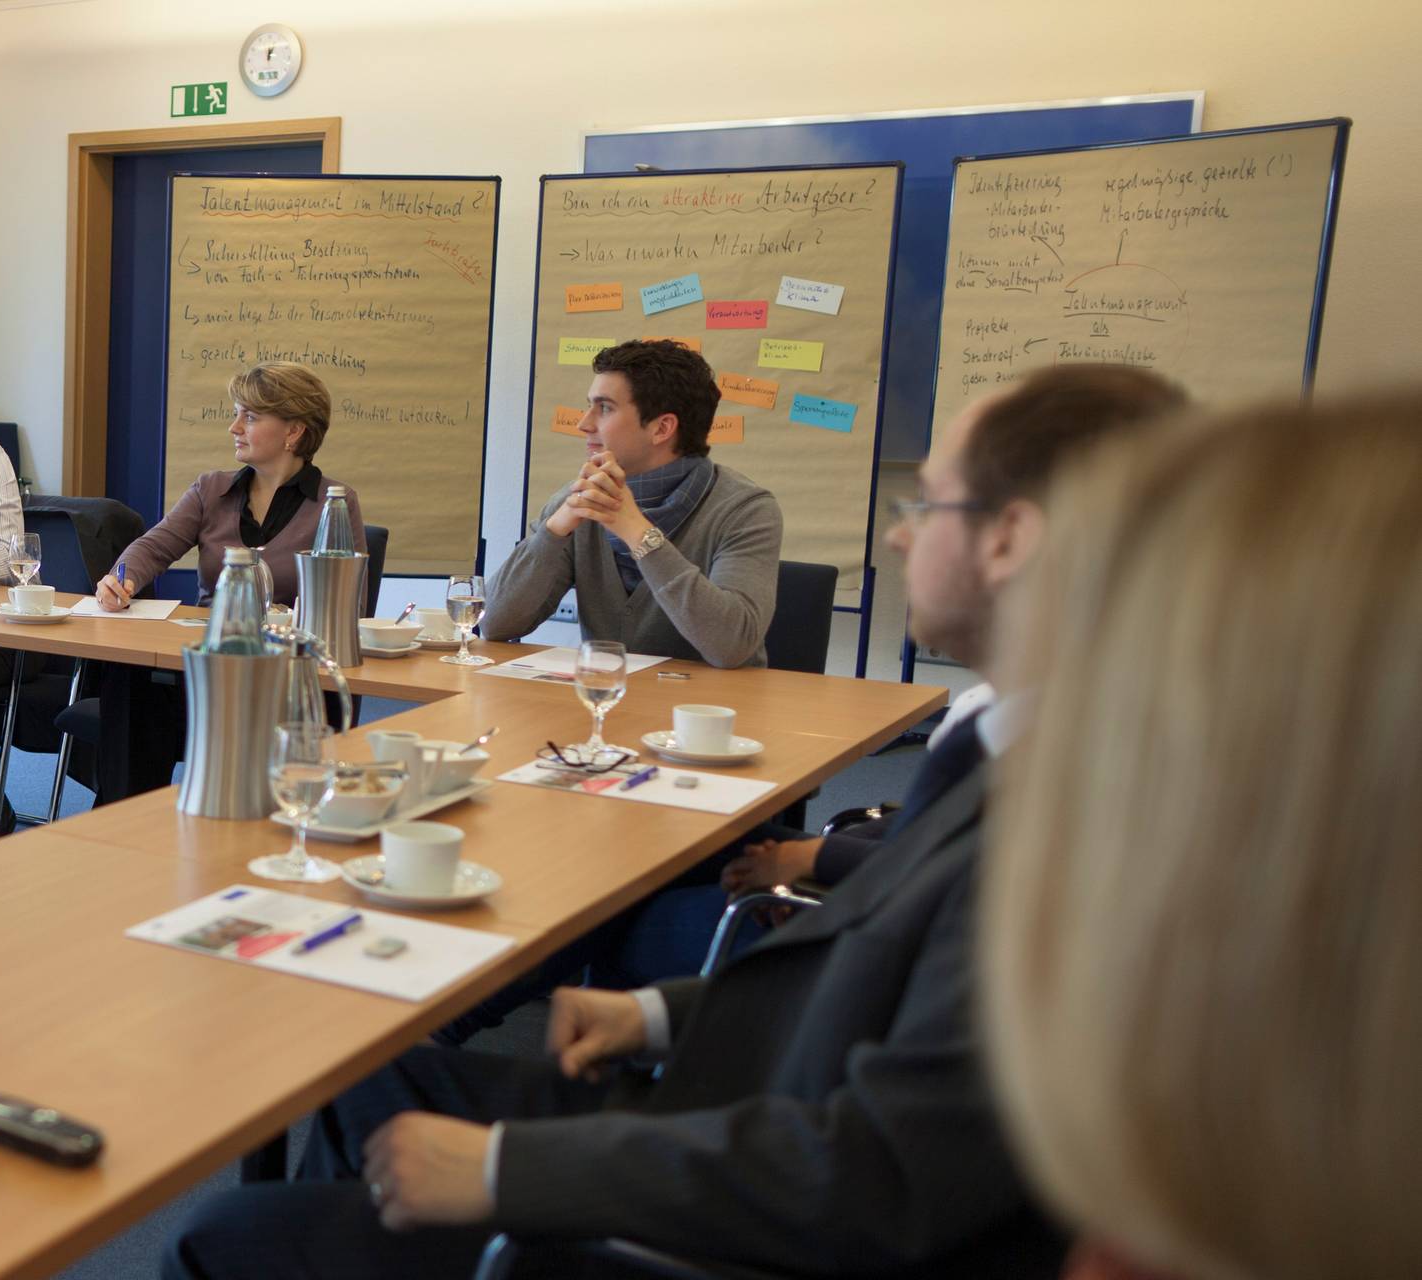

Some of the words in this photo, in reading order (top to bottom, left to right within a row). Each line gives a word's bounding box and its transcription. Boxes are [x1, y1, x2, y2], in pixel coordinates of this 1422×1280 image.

[1201, 157, 1257, 193] gezielte
[200, 186, 342, 222] Talentmanagement
[354, 199, 371, 210] im
[379, 190, 465, 217] Mittelstand
[562, 190, 590, 211] Bin
[602, 190, 620, 208] ich
[627, 197, 650, 208] ein
[661, 184, 743, 207] attraktiver
[756, 179, 859, 217] Arbeitgeber
[865, 178, 876, 195] ?
[1098, 198, 1230, 231] Mitarbeitergespräche
[204, 239, 296, 272] Sicherstellung
[302, 238, 369, 264] Besetzung
[584, 239, 614, 262] Was
[626, 233, 699, 261] erwarten
[710, 229, 805, 257] Mitarbeiter
[815, 227, 824, 245] ?
[1008, 253, 1040, 269] nicht
[205, 270, 229, 284] von
[298, 264, 421, 294] Führungspositionen
[309, 299, 435, 335] Personalrekrutierung
[1063, 288, 1188, 316] Talentmanagement
[1091, 318, 1110, 334] als
[256, 341, 366, 376] Weiterentwicklung
